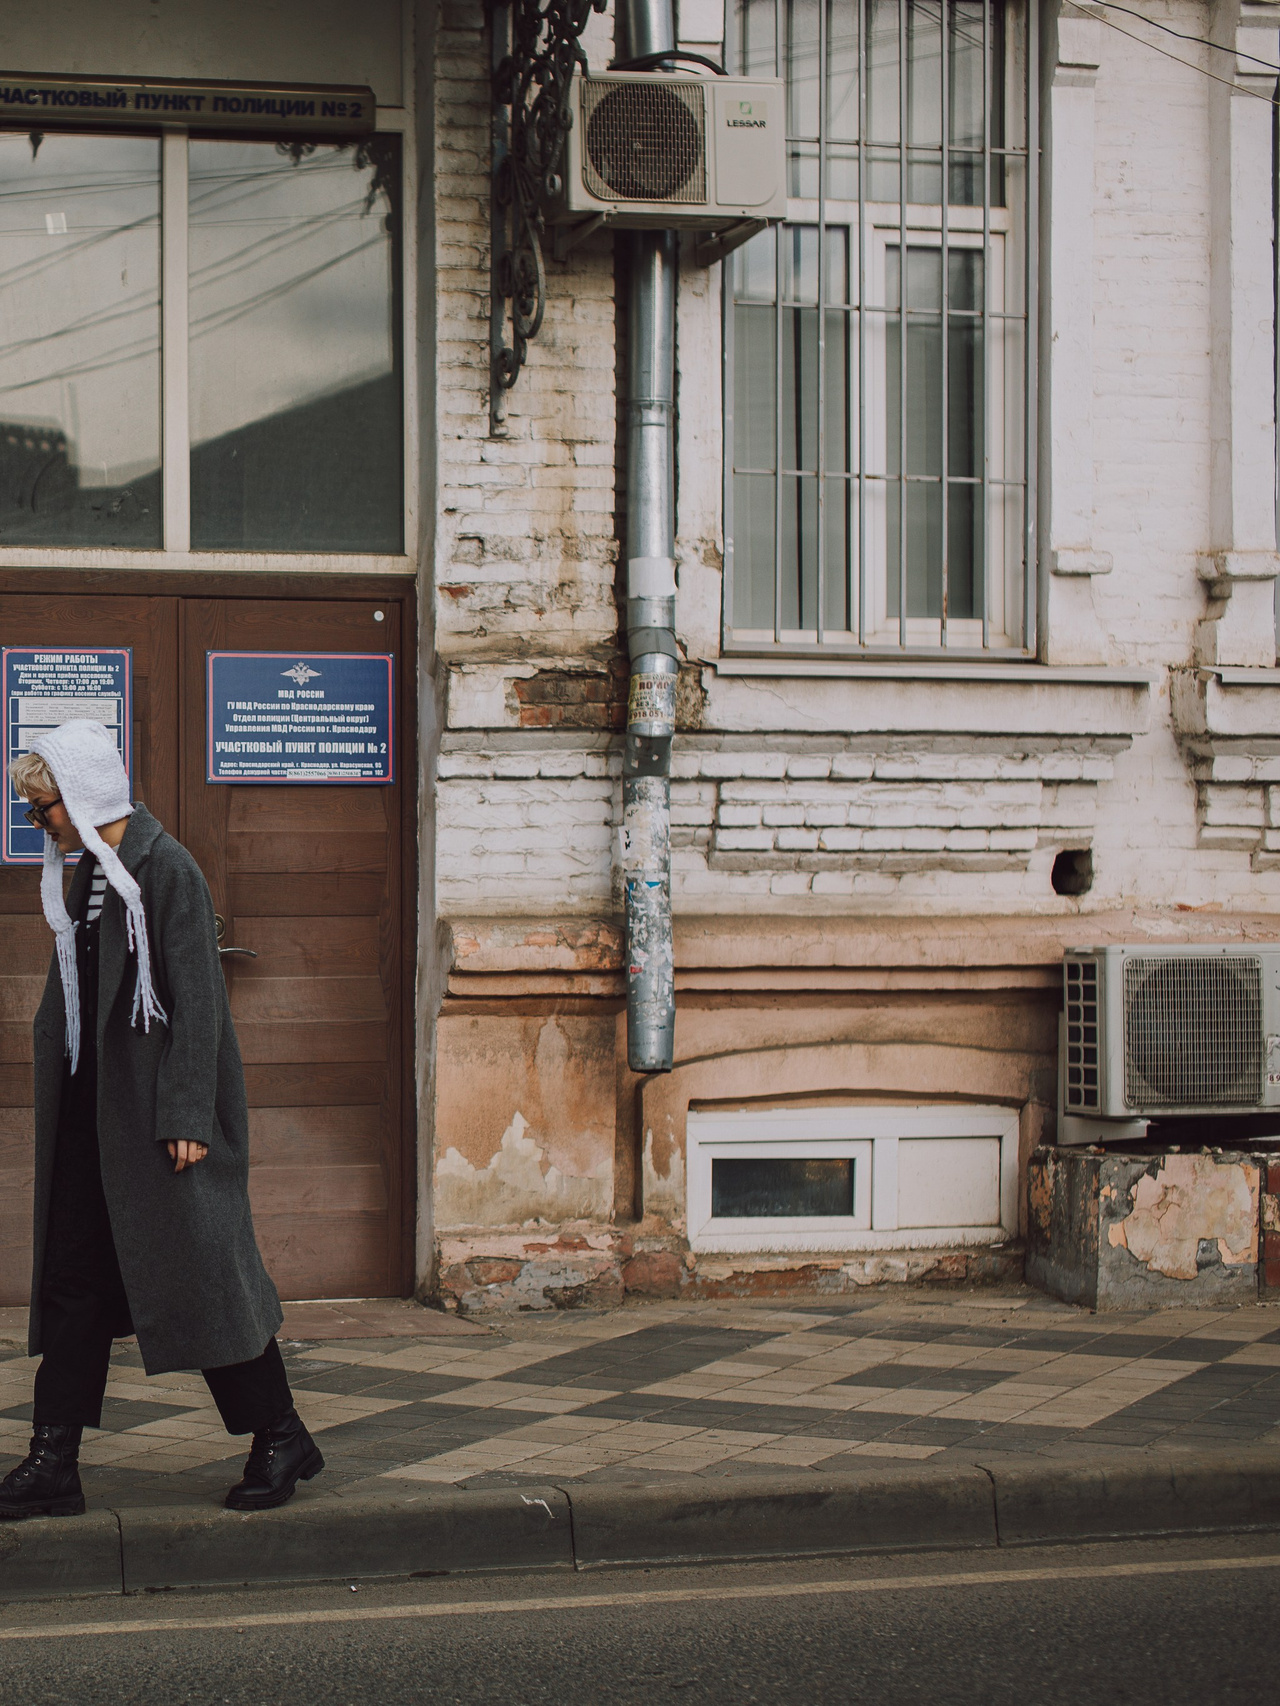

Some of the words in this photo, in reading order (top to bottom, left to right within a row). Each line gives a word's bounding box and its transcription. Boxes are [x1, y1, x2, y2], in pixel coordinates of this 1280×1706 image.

[135, 93, 206, 111] ПУНКТ
[213, 96, 315, 118] ПОЛИЦИИ
[726, 119, 767, 128] LESSAR
[34, 655, 63, 664] РЕЖИМ
[65, 655, 98, 664] РАБОТЫ
[55, 664, 77, 672] ПУНКТА
[278, 690, 294, 699] МВД
[297, 690, 324, 698] РОССИИ
[227, 701, 235, 710] ГУ
[236, 702, 252, 710] МВД
[253, 702, 280, 710] России
[281, 703, 290, 711] по
[291, 702, 354, 712] Краснодарскому
[355, 703, 375, 711] краю
[233, 714, 256, 722] Отдел
[257, 714, 290, 723] полиции
[291, 714, 345, 723] (Центральный
[346, 715, 369, 724] округ)
[225, 724, 271, 732] Управления
[272, 724, 288, 733] МВД
[289, 724, 316, 732] России
[317, 725, 326, 733] по
[332, 725, 377, 734] Краснодару
[216, 740, 282, 753] УЧАСТКОВЫЙ
[285, 742, 316, 753] ПУНКТ
[320, 742, 364, 755] ПОЛИЦИИ
[368, 743, 378, 753] №
[380, 743, 387, 753] 2
